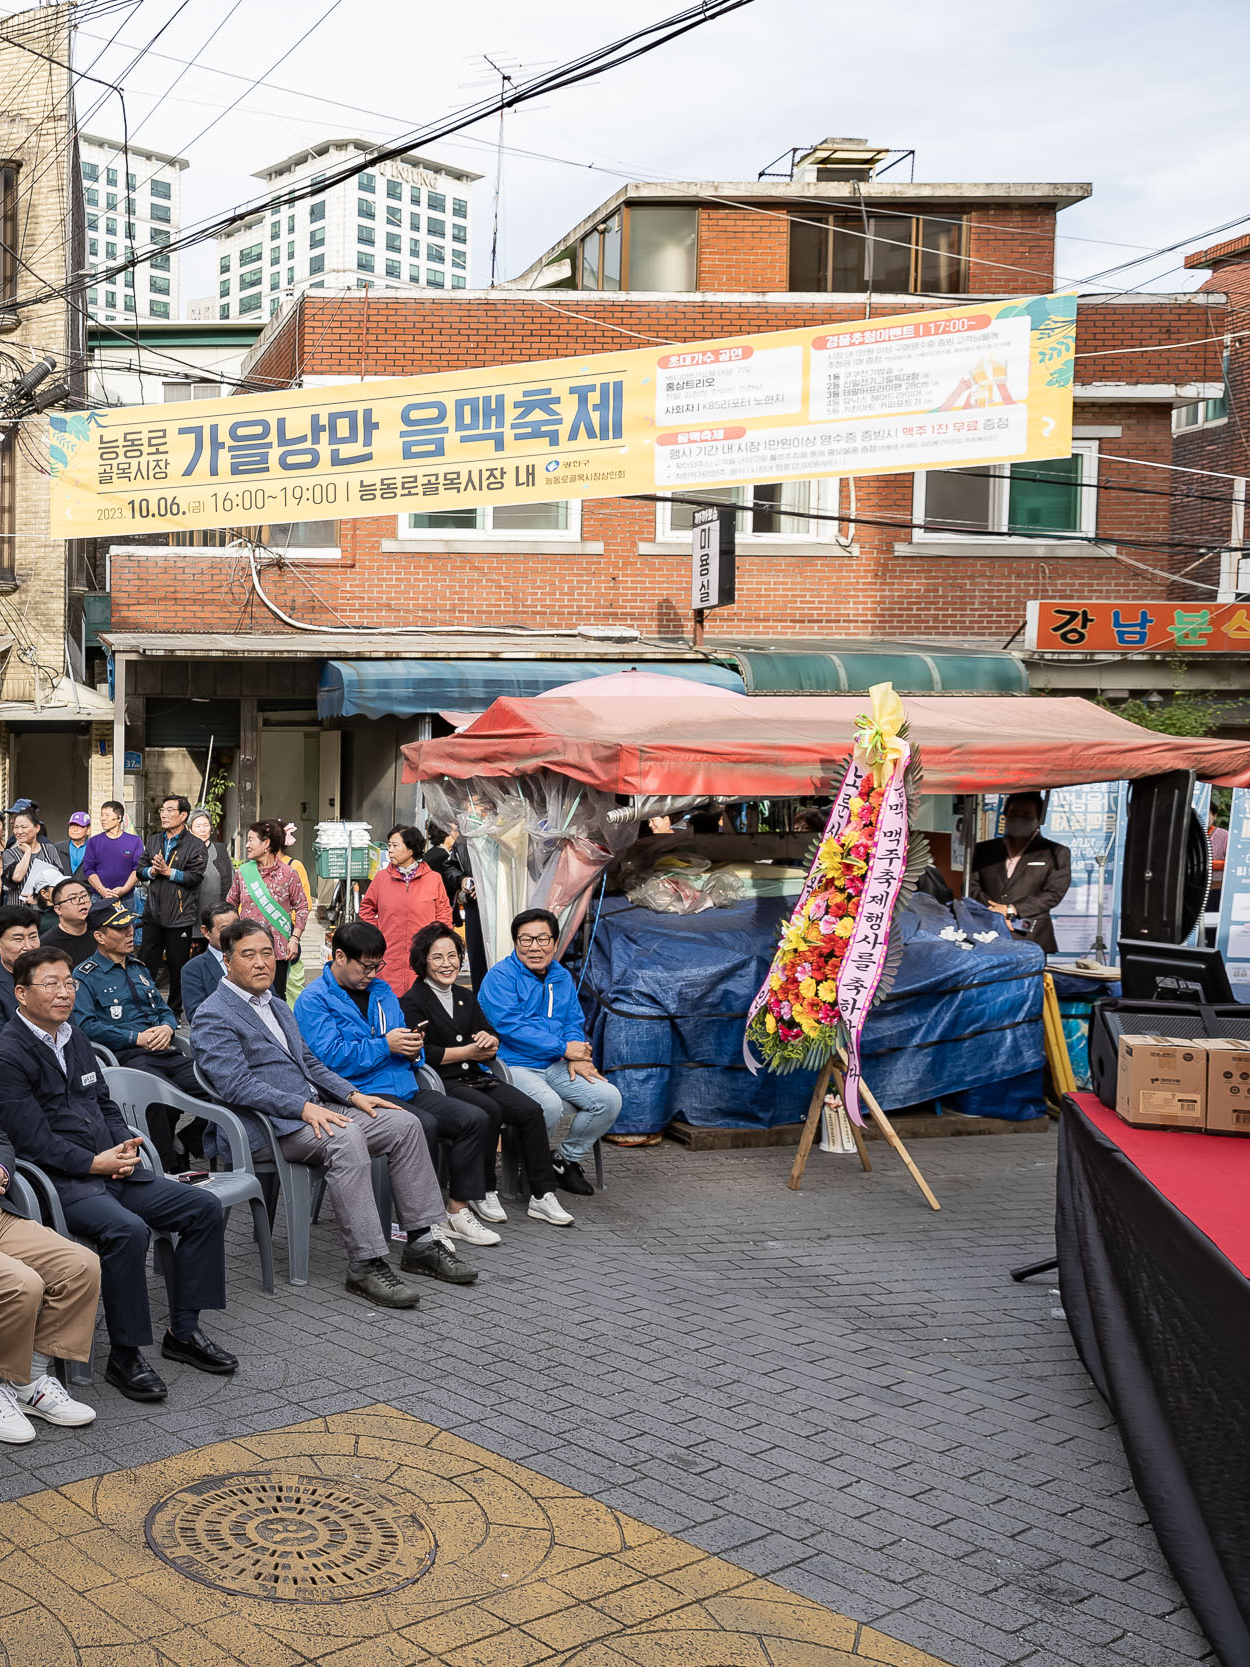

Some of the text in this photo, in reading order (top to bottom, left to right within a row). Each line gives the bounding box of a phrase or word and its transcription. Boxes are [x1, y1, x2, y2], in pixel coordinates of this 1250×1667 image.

[825, 318, 976, 348] 경품추첨이벤트 17:00~
[668, 348, 743, 367] 초대가수 공연
[664, 404, 695, 415] 사회자
[178, 380, 623, 477] 가을낭만 음맥축제
[669, 448, 692, 460] 행사
[696, 445, 719, 457] 기간
[722, 443, 733, 454] 내
[737, 441, 760, 453] 시장
[764, 436, 816, 450] 1만원이상
[820, 432, 857, 446] 영수증
[902, 425, 927, 438] 맥주
[931, 423, 949, 435] 1잔
[953, 420, 979, 432] 무료
[983, 417, 1009, 430] 증정
[97, 428, 169, 462] 능동로
[97, 458, 170, 485] 골목시장
[358, 464, 536, 501] 능동로골목시장 내
[545, 470, 626, 485] 능동로골목시장상인회
[210, 482, 337, 513] 16:00~19:00
[699, 526, 710, 604] 미용실
